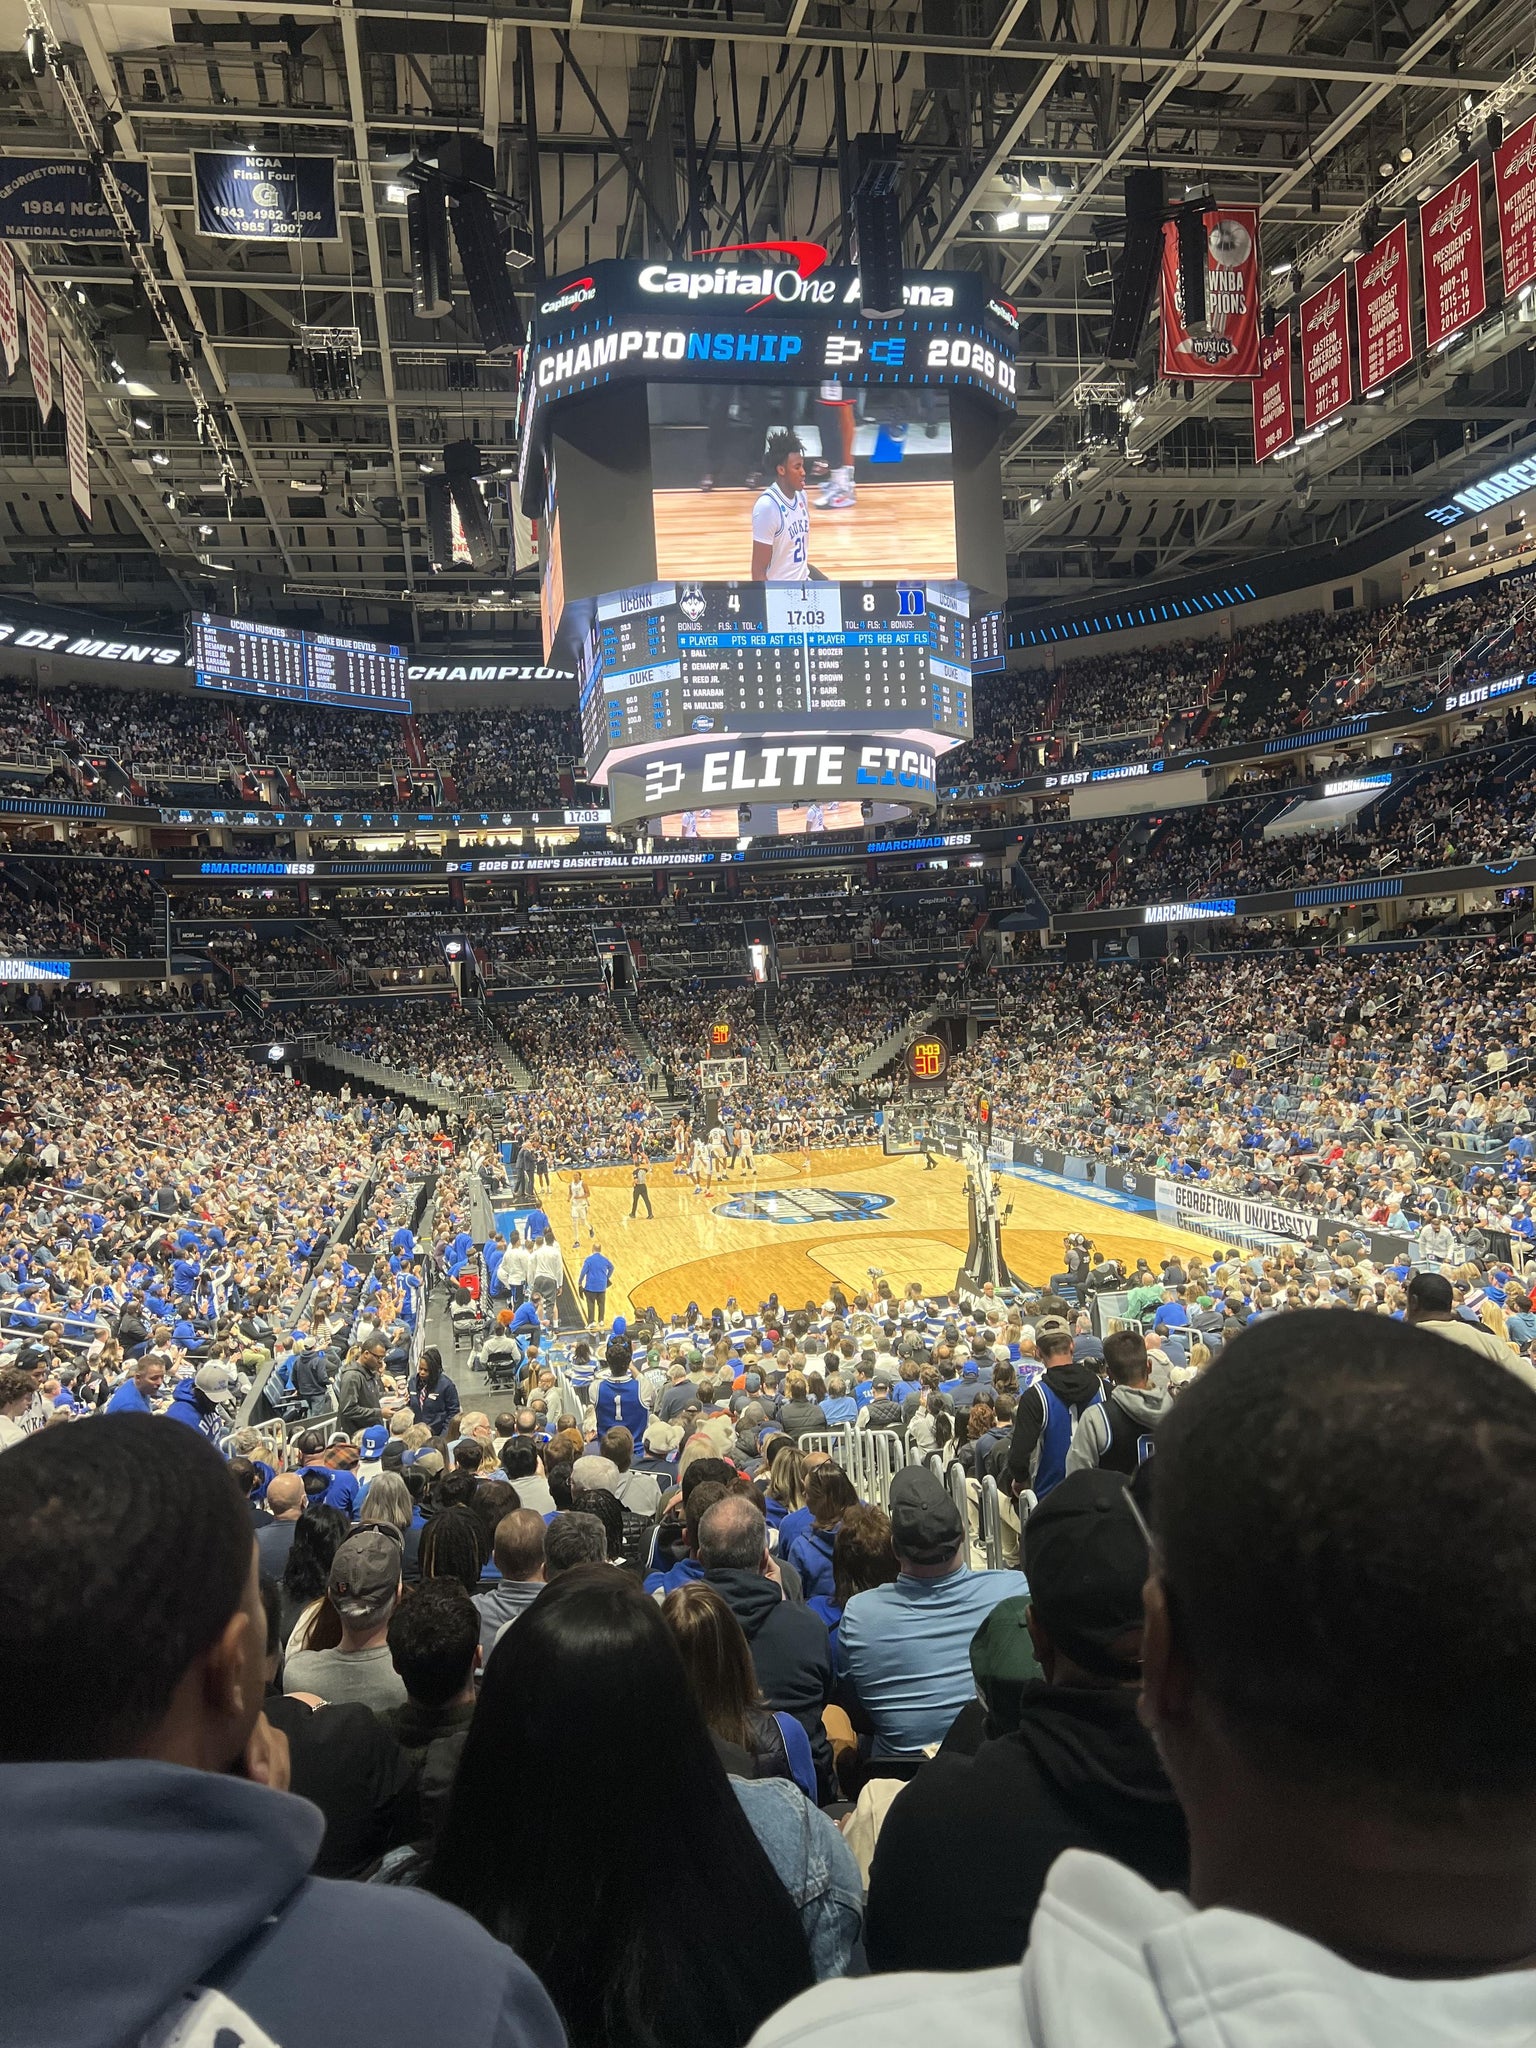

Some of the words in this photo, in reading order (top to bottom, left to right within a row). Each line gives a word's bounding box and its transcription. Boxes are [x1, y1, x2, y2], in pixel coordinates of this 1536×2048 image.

[246, 157, 282, 168] NCAA
[233, 169, 264, 181] Final
[268, 171, 296, 181] Four
[21, 200, 65, 215] 1984
[253, 208, 283, 220] 1982
[291, 211, 322, 220] 1984
[6, 225, 67, 236] NATIONAL
[234, 221, 265, 232] 1985
[1439, 247, 1465, 276] TROPHY
[1208, 270, 1244, 292] WNBA
[1439, 267, 1469, 299] 2009-10
[1440, 284, 1470, 315] 2015-16
[1441, 300, 1470, 332] 2016-17
[1312, 330, 1337, 355] EASTERN
[539, 331, 802, 388] CHAMPIONSHIP
[927, 339, 995, 379] 2026
[998, 360, 1016, 394] DI
[1308, 338, 1343, 372] CONFERENCE
[1309, 352, 1342, 383] CHAMPIONS
[788, 519, 809, 540] DUKE
[728, 594, 740, 612] 4
[863, 594, 875, 611] 8
[678, 623, 703, 631] BONUS:
[718, 622, 732, 630] FLS:
[733, 622, 738, 630] 1
[742, 622, 756, 630] TOL:
[787, 610, 825, 626] 17:03
[845, 621, 859, 629] TOL:
[867, 621, 881, 629] FLS:
[883, 621, 887, 629] 1
[891, 621, 914, 629] BONUS:
[230, 619, 255, 632] UCONN
[255, 624, 286, 638] HUSKIES
[317, 635, 335, 646] DUKE
[336, 638, 353, 649] BLUE
[353, 641, 376, 652] DEVILS
[689, 636, 718, 646] PLAYER
[732, 636, 747, 645] PTS
[751, 635, 766, 645] REB
[770, 635, 784, 645] AST
[789, 634, 803, 644] FLS
[817, 635, 845, 644] PLAYER
[859, 634, 873, 643] PTS
[877, 634, 892, 643] REB
[896, 634, 909, 643] AST
[914, 634, 928, 643] FLS
[65, 637, 182, 665] MEN'S
[691, 649, 707, 657] BALL
[818, 648, 843, 656] BOOZER
[692, 662, 719, 670] DEMARY
[720, 662, 730, 670] JR.
[629, 669, 654, 686] DUKE
[692, 675, 708, 683] REED
[709, 675, 720, 683] JR.
[820, 674, 843, 682] BROWN
[683, 689, 690, 697] 11
[694, 688, 724, 696] KARABAN
[1459, 685, 1489, 707] ELITE
[1489, 674, 1525, 698] EIGHT
[683, 702, 692, 710] 24
[694, 702, 724, 710] MULLINS
[821, 699, 845, 707] BOOZER
[701, 746, 845, 793] ELITE
[1060, 771, 1090, 785] EAST
[1092, 764, 1150, 782] REGIONAL
[1324, 773, 1393, 797] MARCHMADNESS
[531, 813, 539, 823] 4
[569, 810, 600, 822] 17:03
[867, 834, 972, 853] #MARCHMADNESS
[201, 862, 315, 875] #MARCHMADNESS
[478, 861, 508, 871] 2026
[511, 860, 525, 870] DI
[527, 859, 560, 869] MEN'S
[562, 858, 630, 868] BASKETBALL
[632, 854, 715, 866] CHAMPIONSHIP
[1144, 899, 1237, 924] MARCHMADNESS
[713, 1032, 728, 1043] 30
[916, 1044, 940, 1056] 17:03
[915, 1055, 939, 1075] 30
[1175, 1186, 1240, 1223] GEORGETOWN
[1244, 1204, 1312, 1239] UNIVERSITY
[614, 1394, 623, 1421] 1
